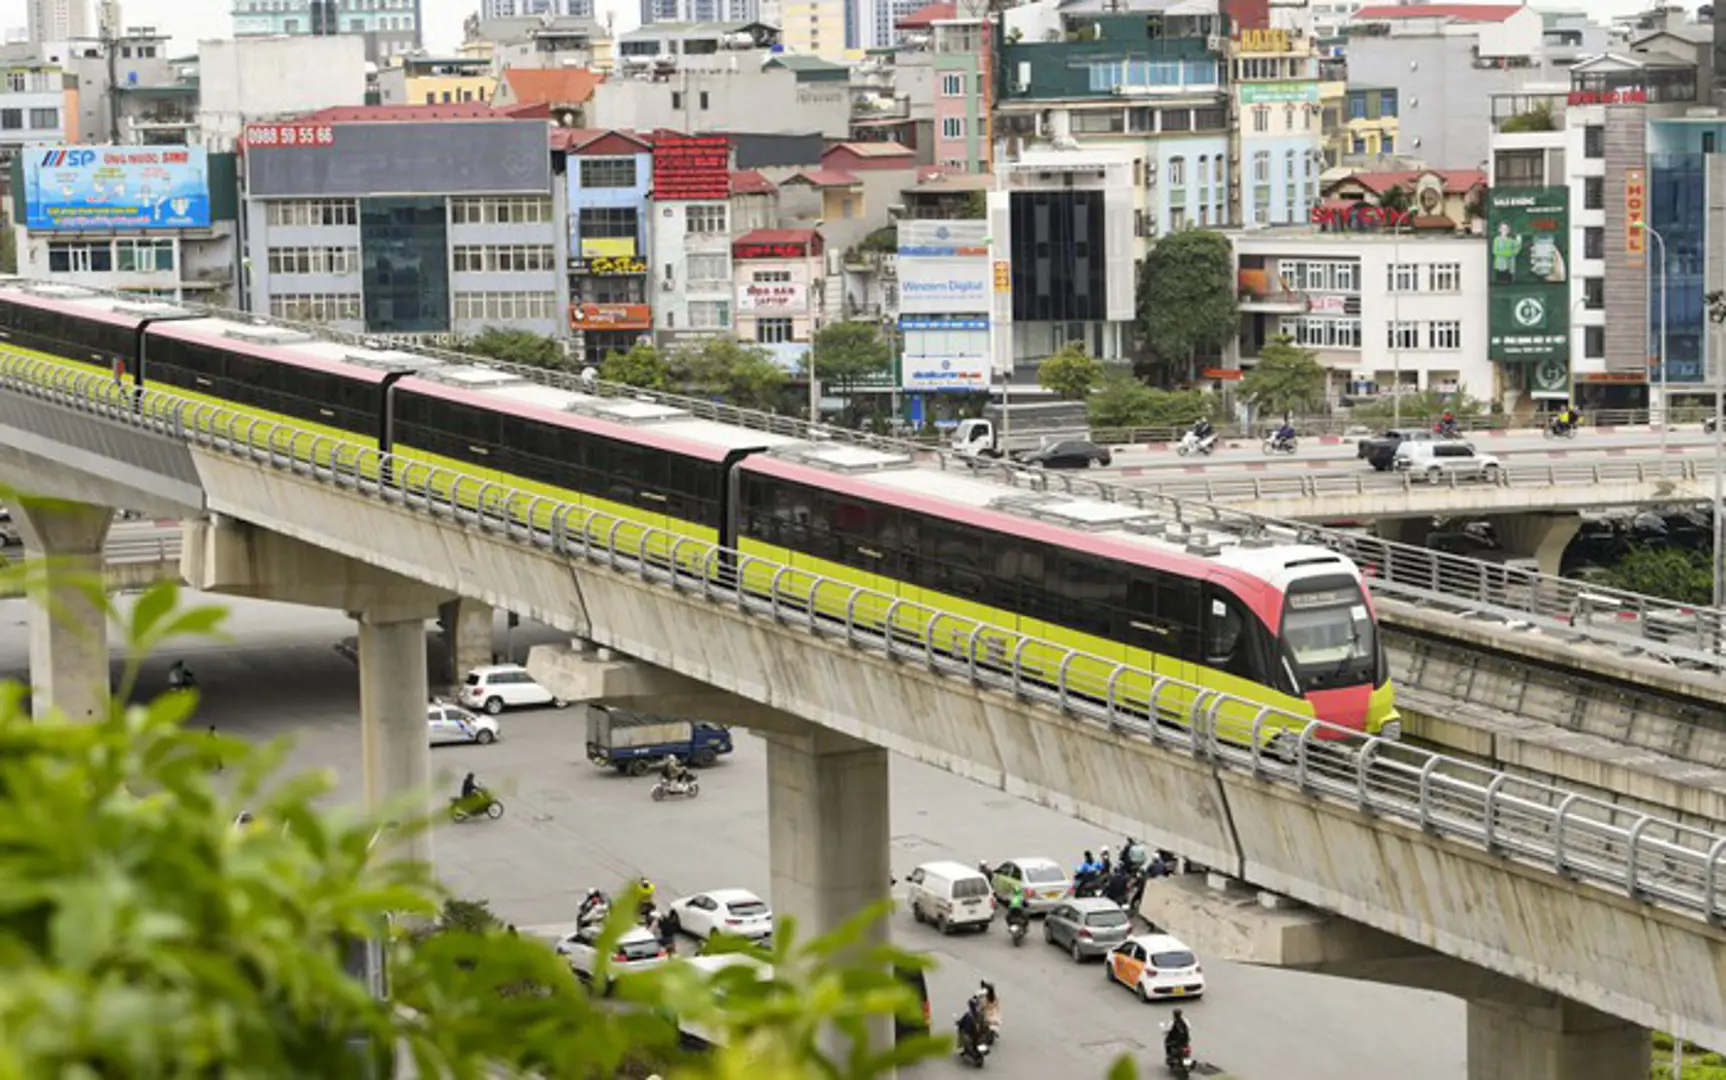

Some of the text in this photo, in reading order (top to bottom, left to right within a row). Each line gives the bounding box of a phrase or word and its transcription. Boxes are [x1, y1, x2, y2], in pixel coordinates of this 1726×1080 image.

[1241, 28, 1288, 52] HOTEL
[68, 150, 96, 167] SP
[1628, 185, 1643, 250] HOTEL
[902, 280, 984, 294] Western Digital
